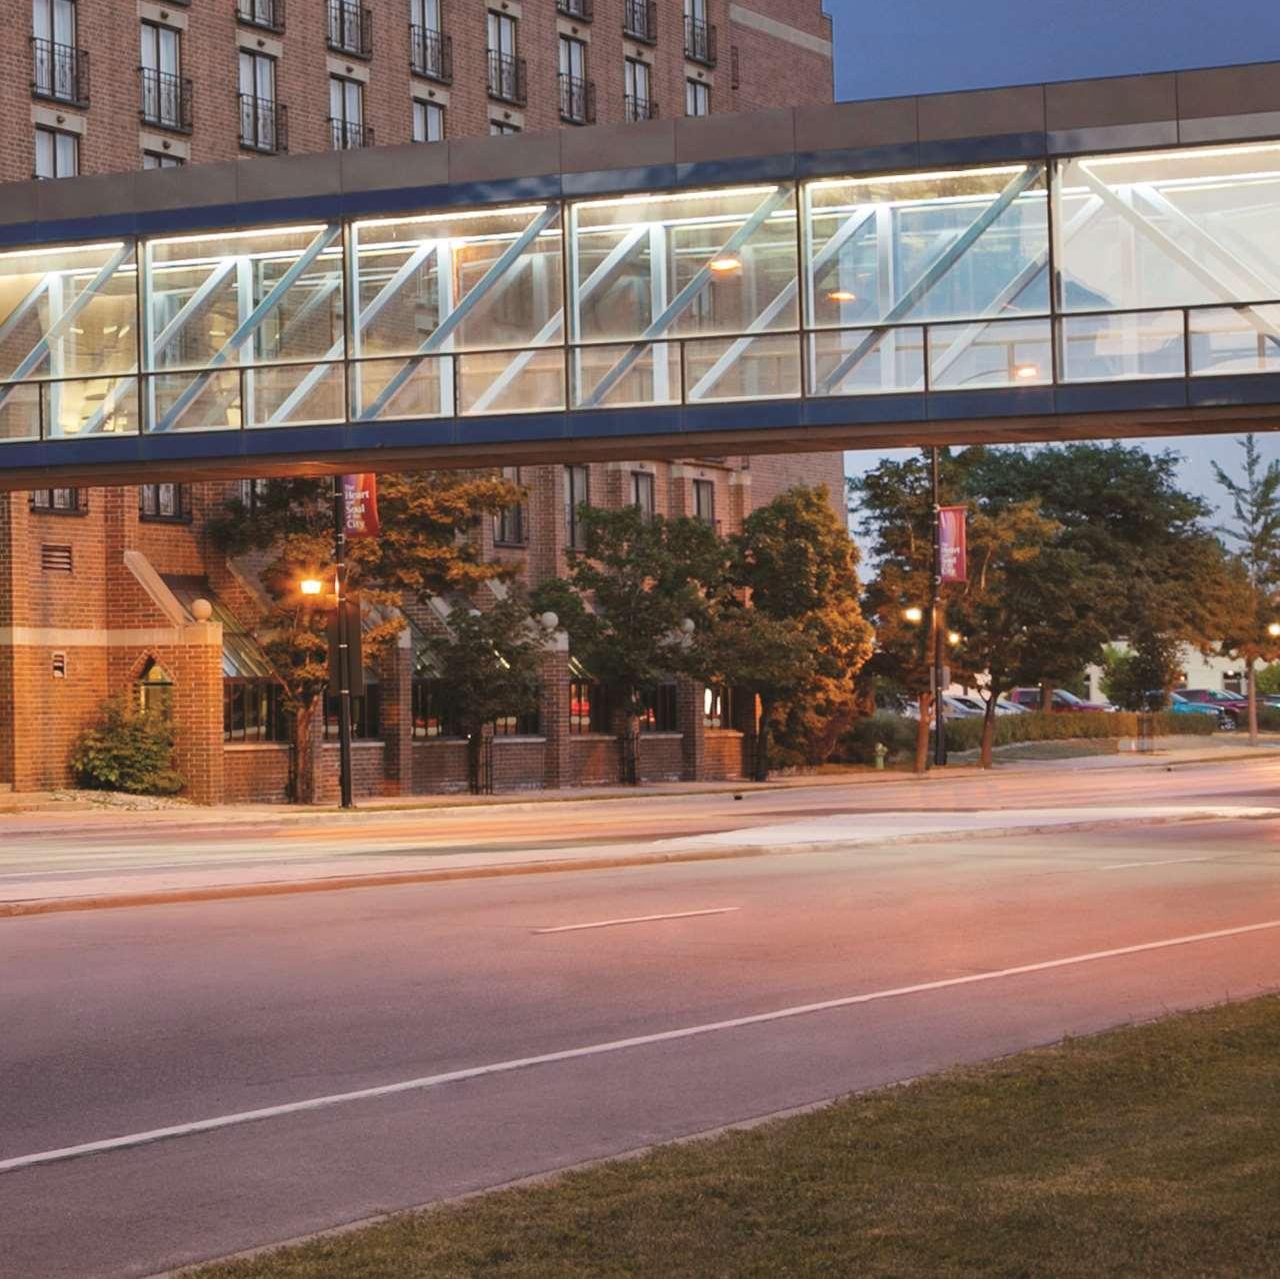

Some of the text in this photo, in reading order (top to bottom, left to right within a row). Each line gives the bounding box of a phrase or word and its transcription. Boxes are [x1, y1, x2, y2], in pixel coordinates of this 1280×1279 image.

[344, 490, 369, 499] Heart
[345, 504, 365, 513] Soul
[346, 520, 365, 530] City
